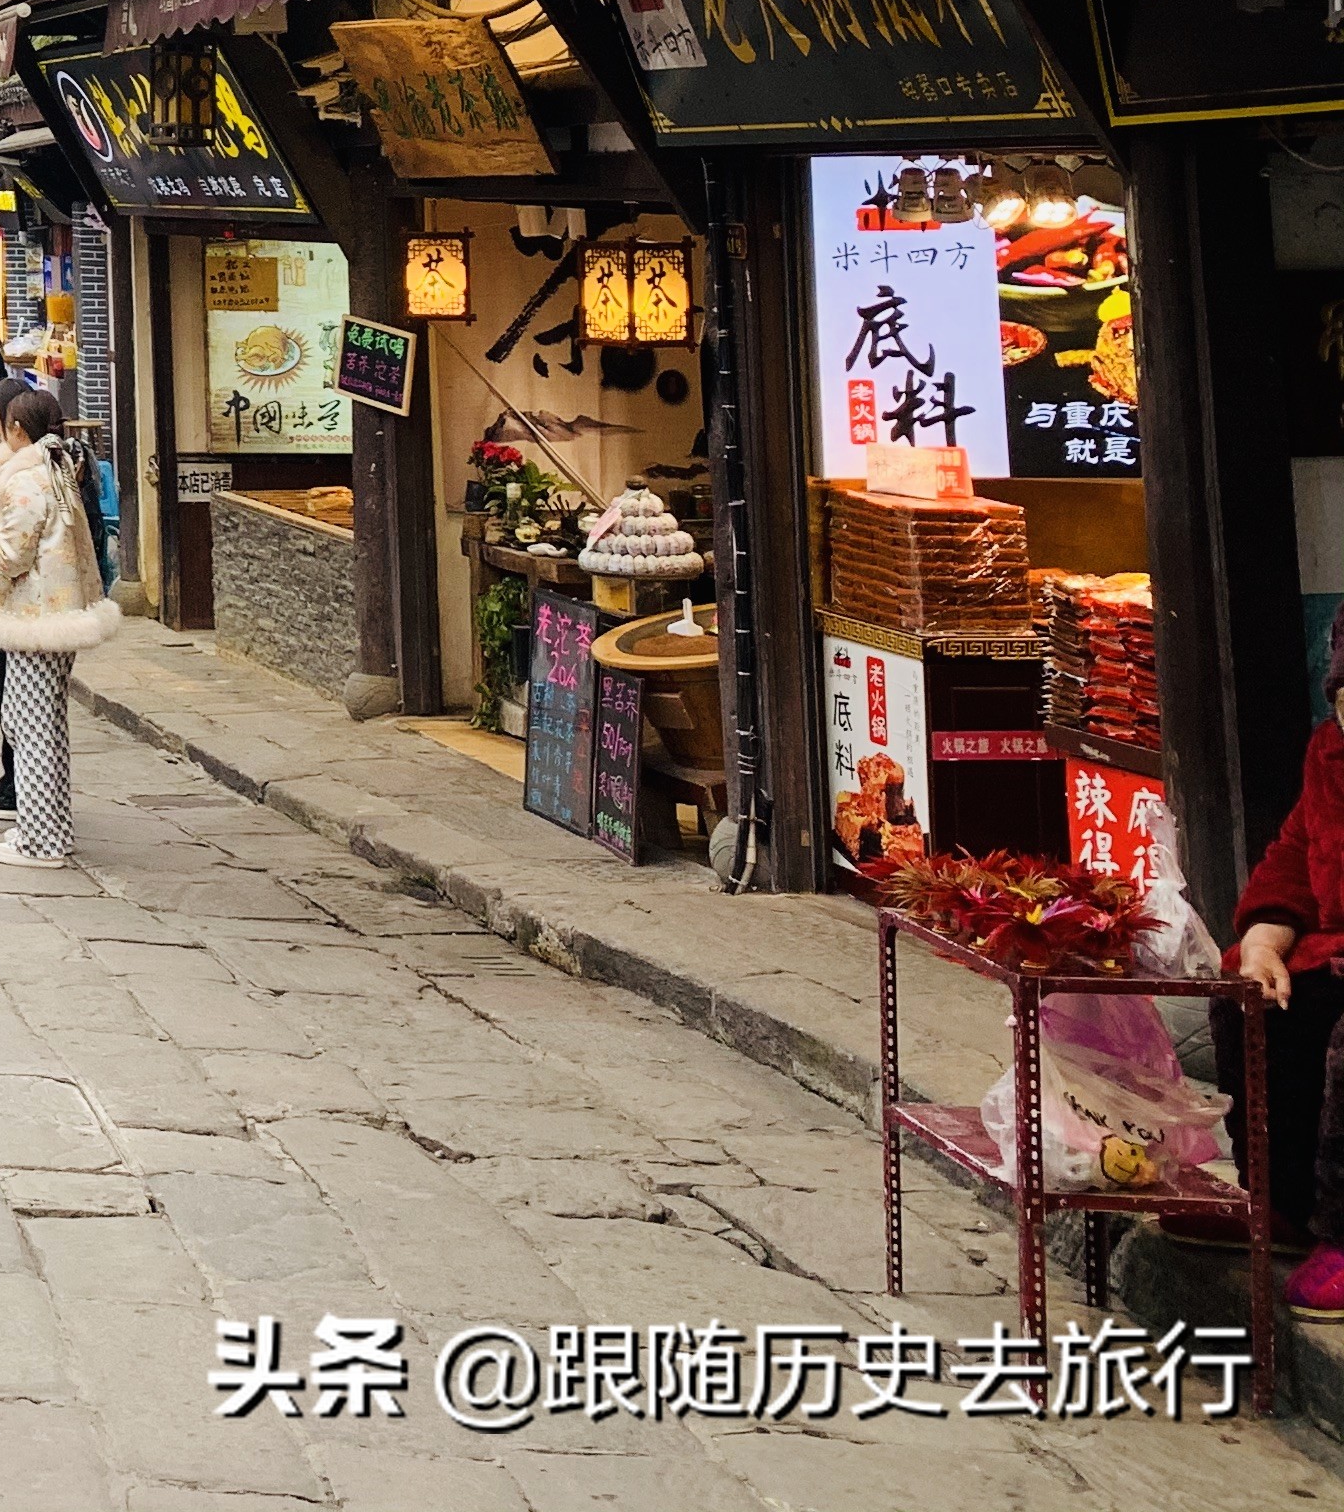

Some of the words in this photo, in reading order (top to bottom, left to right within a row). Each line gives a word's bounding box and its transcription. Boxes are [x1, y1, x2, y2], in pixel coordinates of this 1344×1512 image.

[832, 240, 976, 272] 米斗四方
[850, 382, 875, 441] 老火锅
[1024, 401, 1135, 431] 与重庆
[1065, 436, 1138, 467] 就是
[535, 602, 593, 661] 老沱茶
[868, 662, 887, 742] 老火锅
[833, 691, 856, 781] 底料
[941, 736, 991, 756] 火锅之旅
[1000, 736, 1049, 756] 火锅之旅
